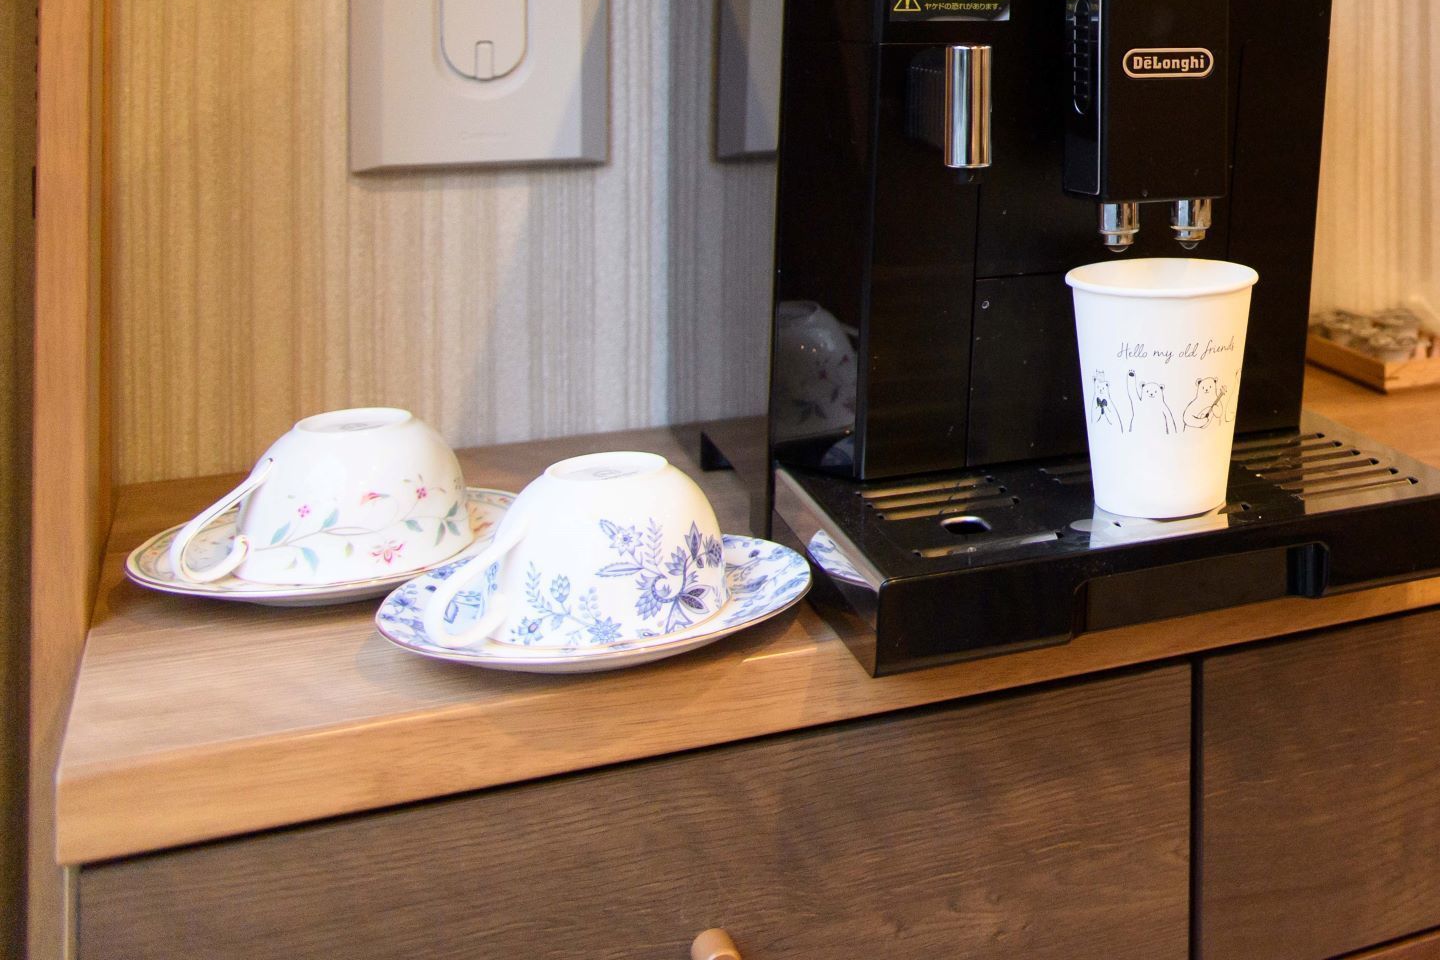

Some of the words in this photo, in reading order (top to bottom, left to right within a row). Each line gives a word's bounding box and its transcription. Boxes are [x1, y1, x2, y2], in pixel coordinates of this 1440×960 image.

[1116, 342, 1148, 360] Hello
[1152, 349, 1174, 364] my
[1178, 342, 1199, 358] old
